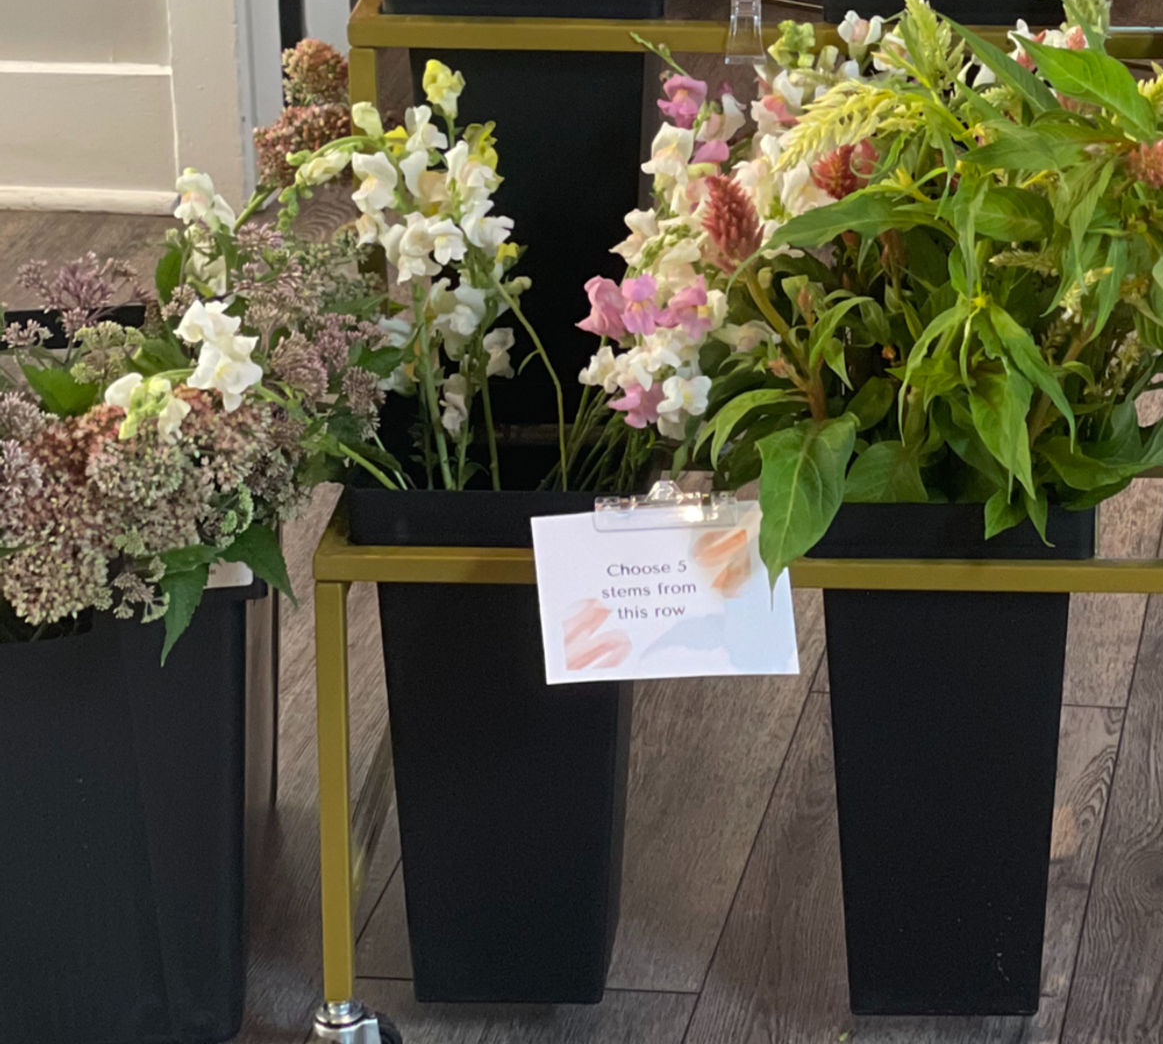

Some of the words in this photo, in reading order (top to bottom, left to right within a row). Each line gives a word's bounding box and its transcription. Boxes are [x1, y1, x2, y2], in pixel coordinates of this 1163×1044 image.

[606, 562, 671, 578] Choose
[677, 559, 688, 574] 5
[601, 585, 651, 600] stems
[657, 581, 697, 596] from
[617, 605, 648, 620] this
[654, 605, 687, 618] row
